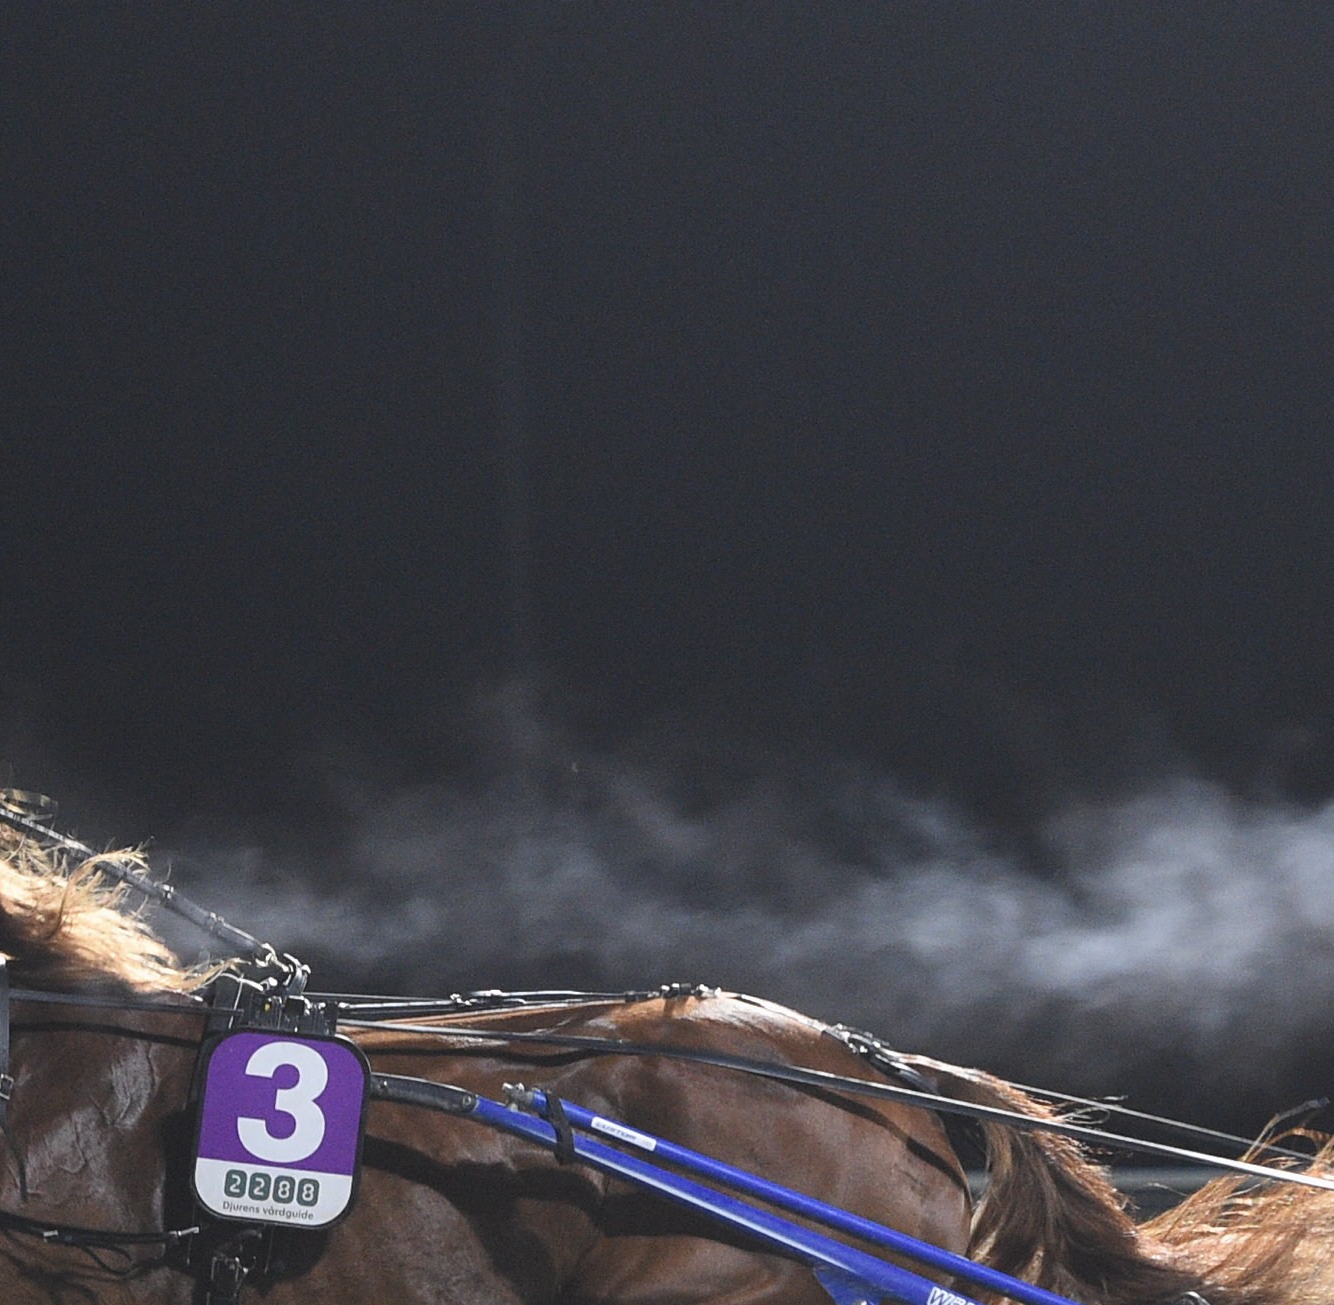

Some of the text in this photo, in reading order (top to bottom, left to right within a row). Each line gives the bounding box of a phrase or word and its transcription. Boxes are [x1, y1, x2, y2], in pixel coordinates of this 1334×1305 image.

[237, 1041, 328, 1163] 3
[227, 1172, 317, 1204] 2288
[222, 1201, 314, 1220] Djurens vårdguide
